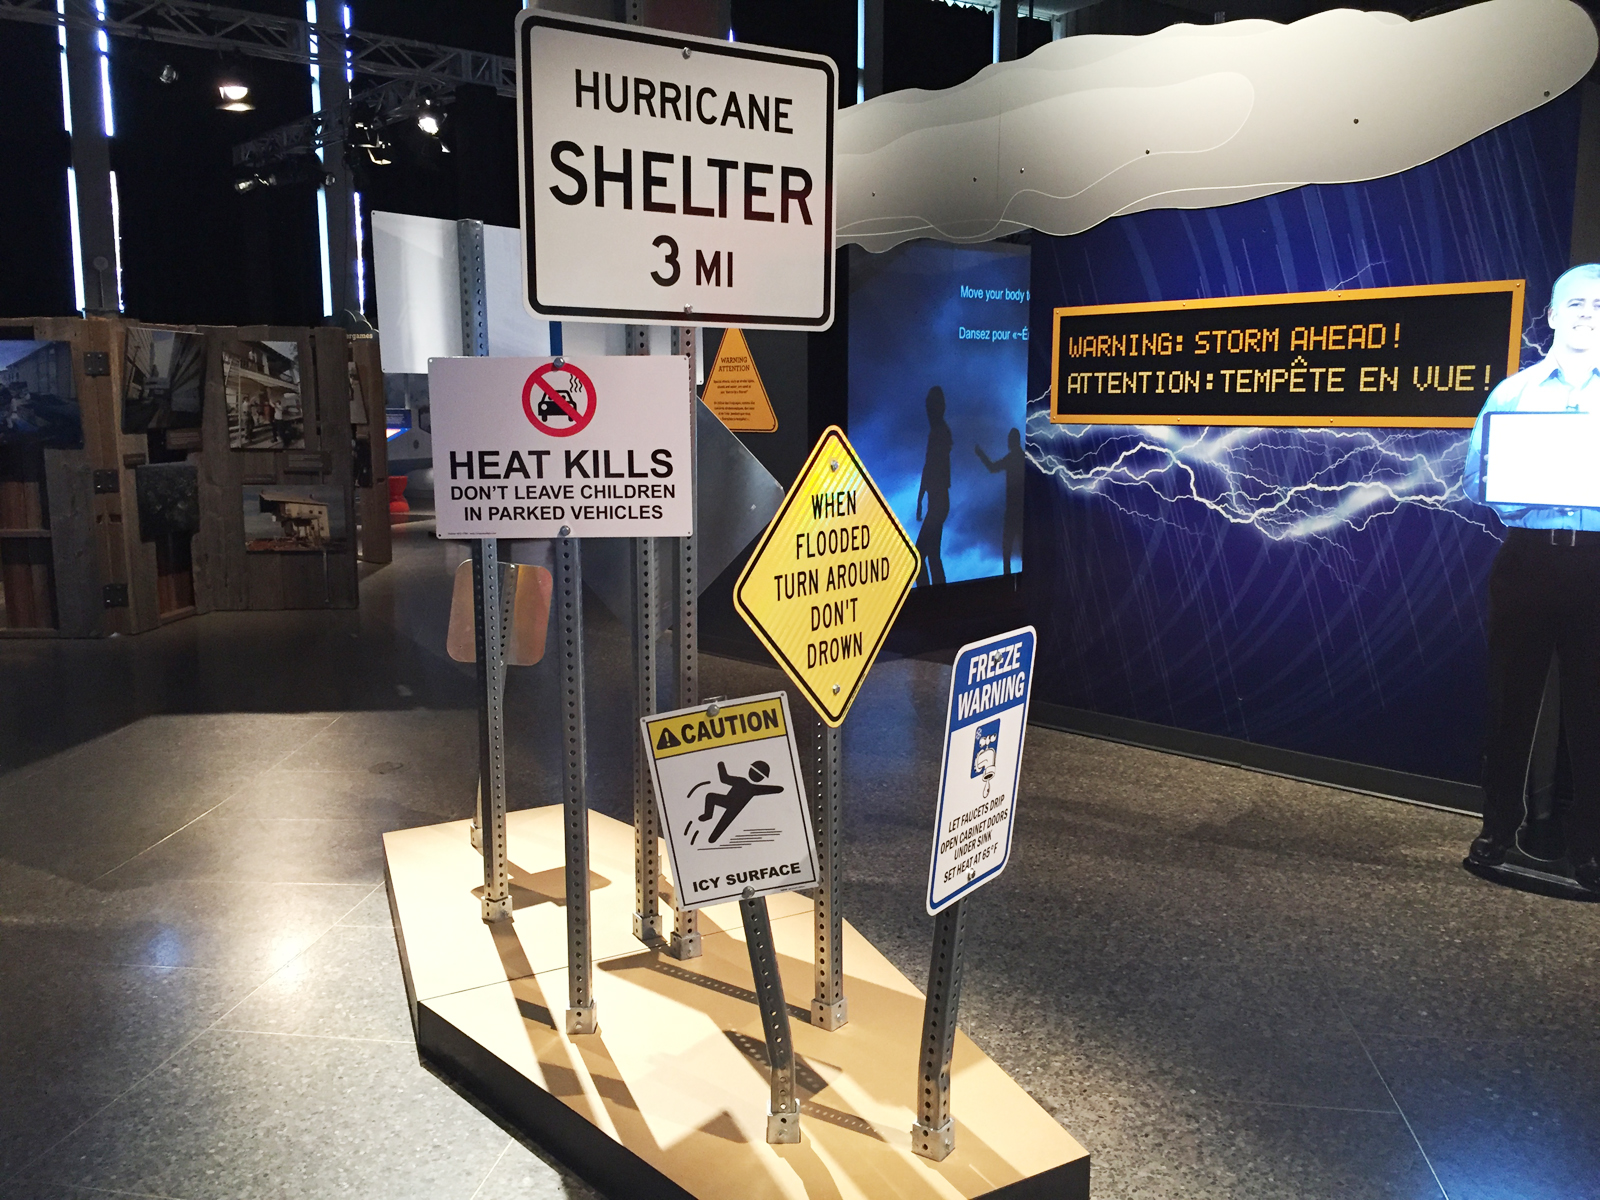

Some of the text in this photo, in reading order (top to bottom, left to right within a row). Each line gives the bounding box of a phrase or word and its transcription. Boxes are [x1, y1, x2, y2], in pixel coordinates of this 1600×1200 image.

[575, 69, 793, 134] HURRICANE
[550, 140, 813, 225] SHELTER
[650, 235, 733, 288] 3 MI
[960, 285, 984, 298] Move
[986, 289, 1003, 302] your
[1005, 288, 1024, 303] body
[959, 326, 990, 340] Dansez
[992, 330, 1010, 342] pour
[1068, 322, 1400, 358] WARNING: STORM AHEAD!
[1067, 355, 1491, 394] ATTENTION: TEMPÊTE EN VUE!
[450, 448, 674, 480] HEAT KILLS
[514, 484, 574, 500] LEAVE
[580, 484, 675, 499] CHILDREN
[811, 490, 857, 520] WHEN
[464, 504, 663, 521] IN PARKED VEHICLES
[796, 524, 870, 560] FLOODED
[774, 557, 890, 602] TURN AROUND
[811, 598, 858, 632] DON'T
[807, 632, 863, 669] DROWN
[968, 642, 1023, 685] FREEZE
[958, 671, 1026, 721] WARNING
[681, 708, 779, 744] CAUTION
[940, 808, 1008, 854] OPEN CABINET DOORS
[948, 794, 1005, 833] LET FAUCETS DRIP
[954, 830, 992, 860] UNDER SINK
[692, 862, 801, 893] ICY SURFACE
[944, 866, 956, 883] SET
[956, 856, 973, 875] HEAT
[973, 852, 982, 866] AT
